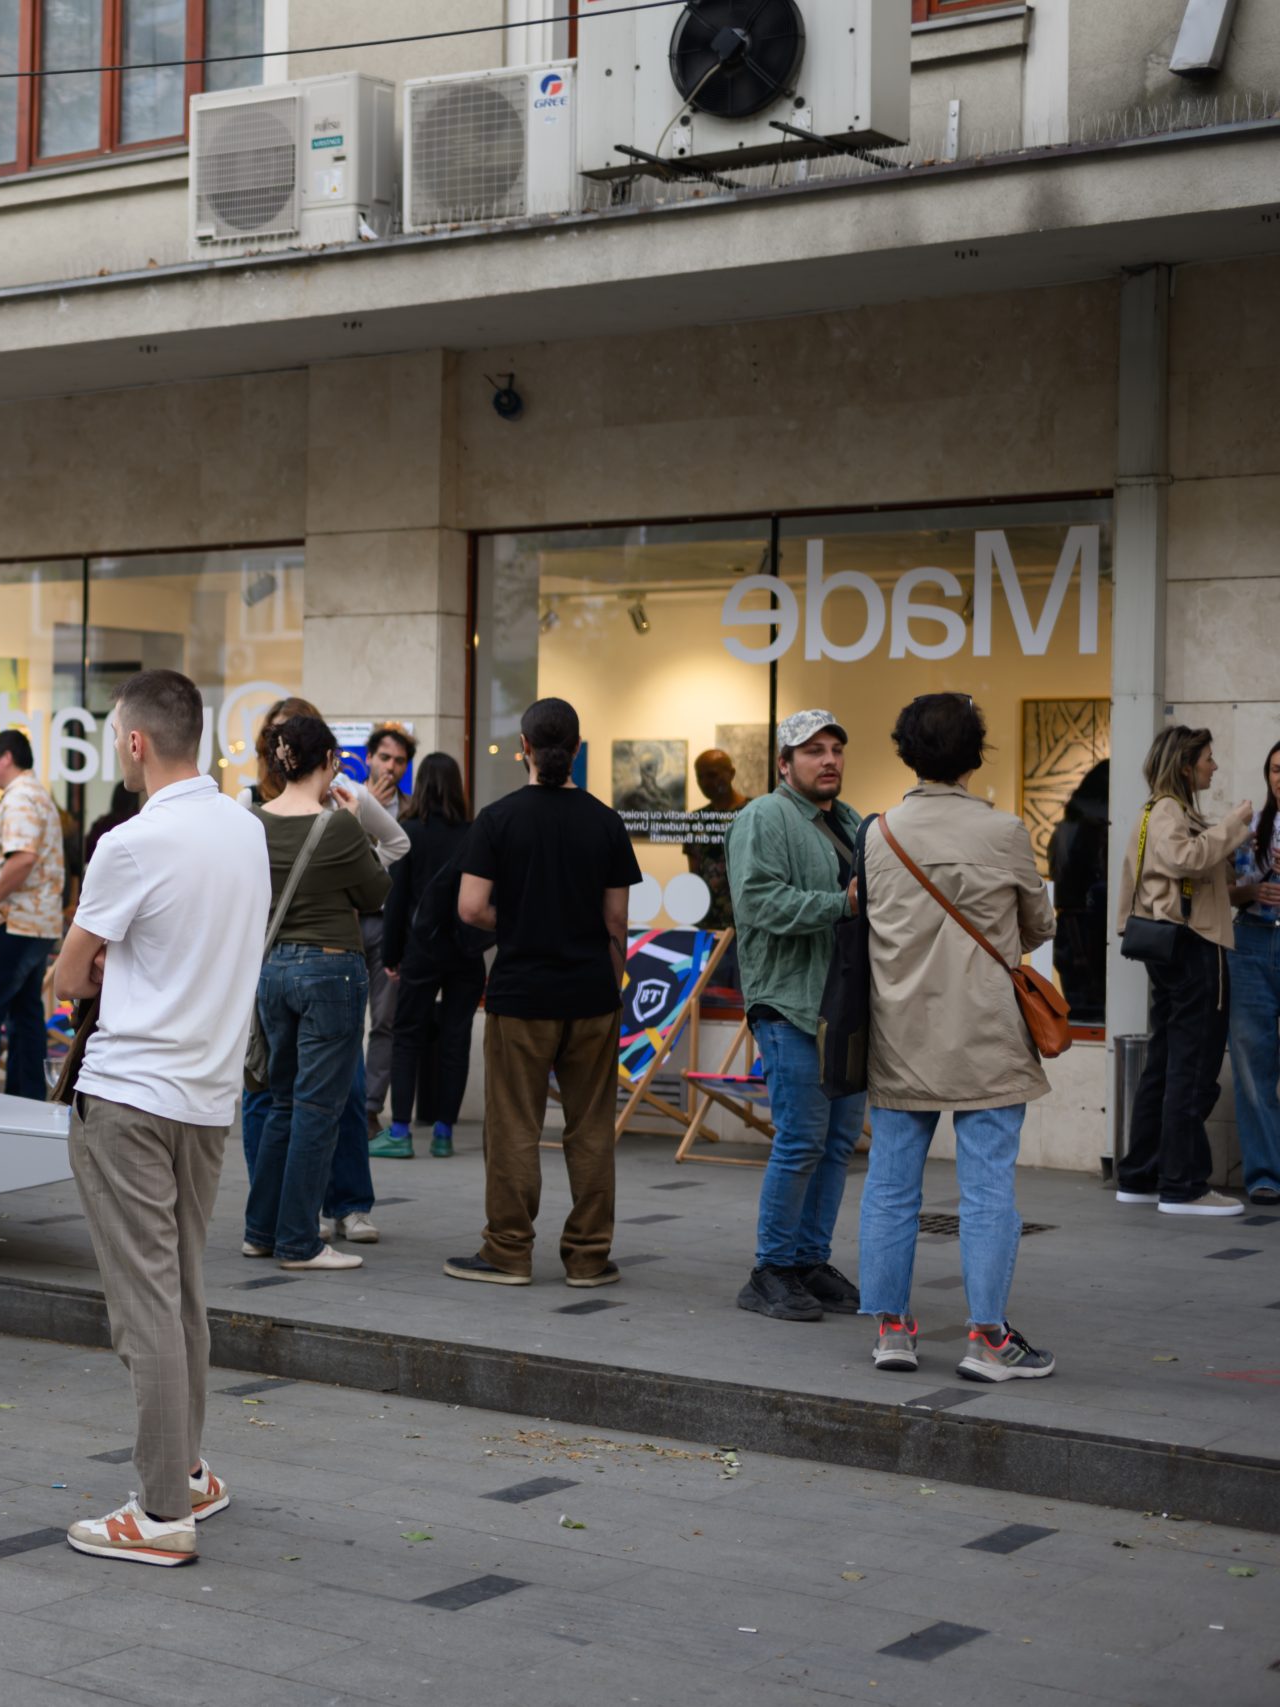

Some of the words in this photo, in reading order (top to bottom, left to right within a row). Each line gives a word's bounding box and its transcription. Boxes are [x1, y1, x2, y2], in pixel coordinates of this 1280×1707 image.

[533, 96, 568, 109] GREE
[640, 989, 661, 1003] BT
[106, 1513, 144, 1541] N
